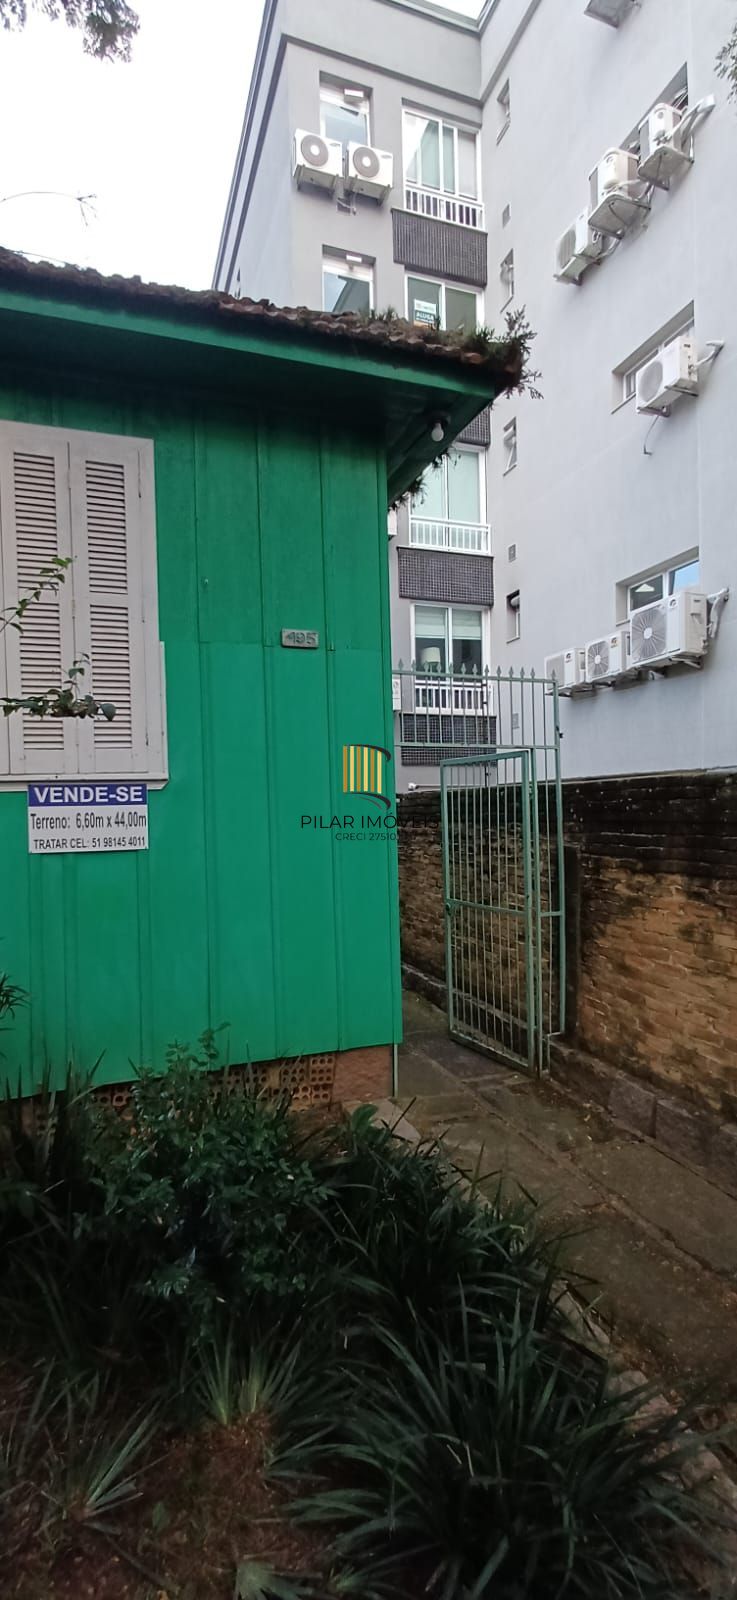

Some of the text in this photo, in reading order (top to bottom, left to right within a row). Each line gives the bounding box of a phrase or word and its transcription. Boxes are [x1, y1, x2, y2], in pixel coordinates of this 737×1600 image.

[34, 786, 143, 803] VENDE-SE
[30, 811, 147, 830] Terreno: 6,60m x 44,00m
[34, 838, 68, 850] TRATAR
[92, 837, 101, 848] 51
[103, 836, 127, 848] 98145
[128, 836, 146, 847] 4011
